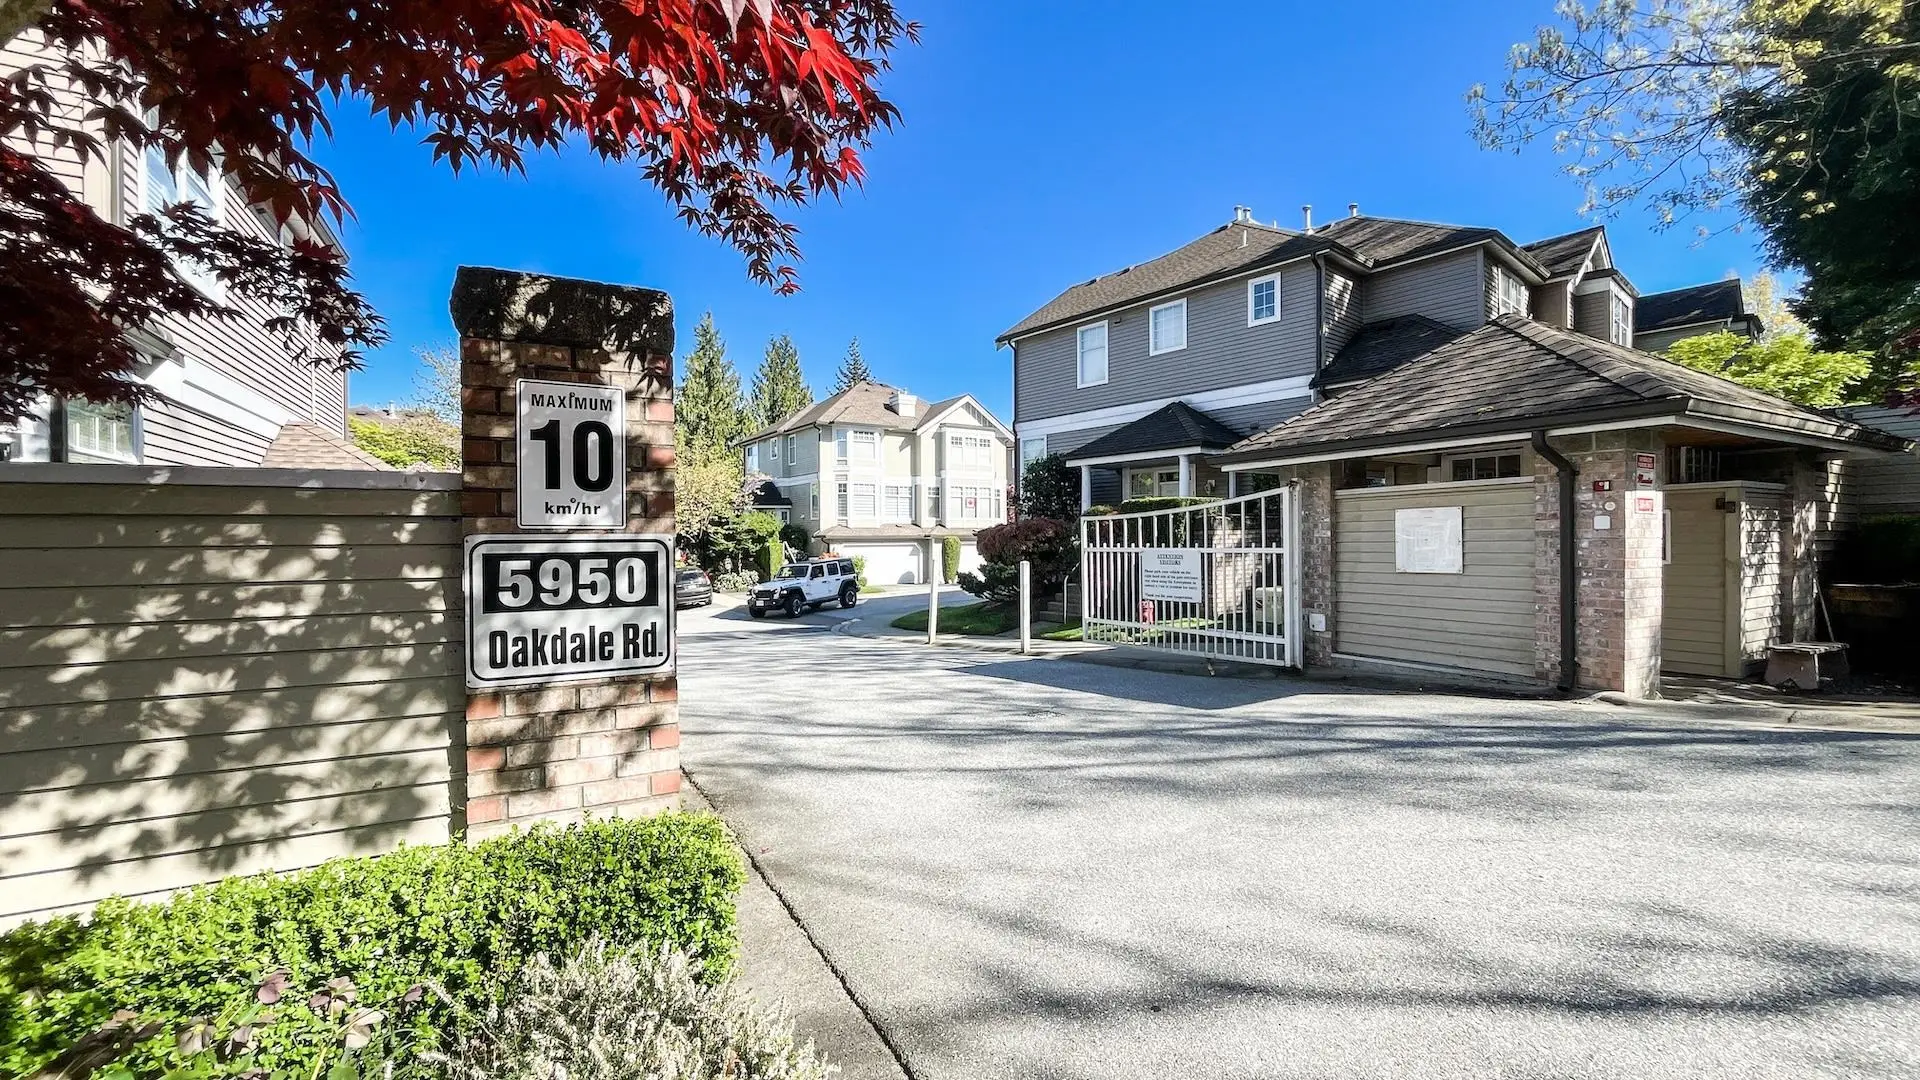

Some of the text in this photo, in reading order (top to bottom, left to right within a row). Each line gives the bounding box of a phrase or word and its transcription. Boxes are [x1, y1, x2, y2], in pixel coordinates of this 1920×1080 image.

[531, 393, 612, 412] MAXIMUM
[530, 419, 613, 492] 10
[545, 501, 601, 515] km/hr
[498, 557, 647, 608] 5950
[489, 621, 664, 669] Oakdale Rd.
